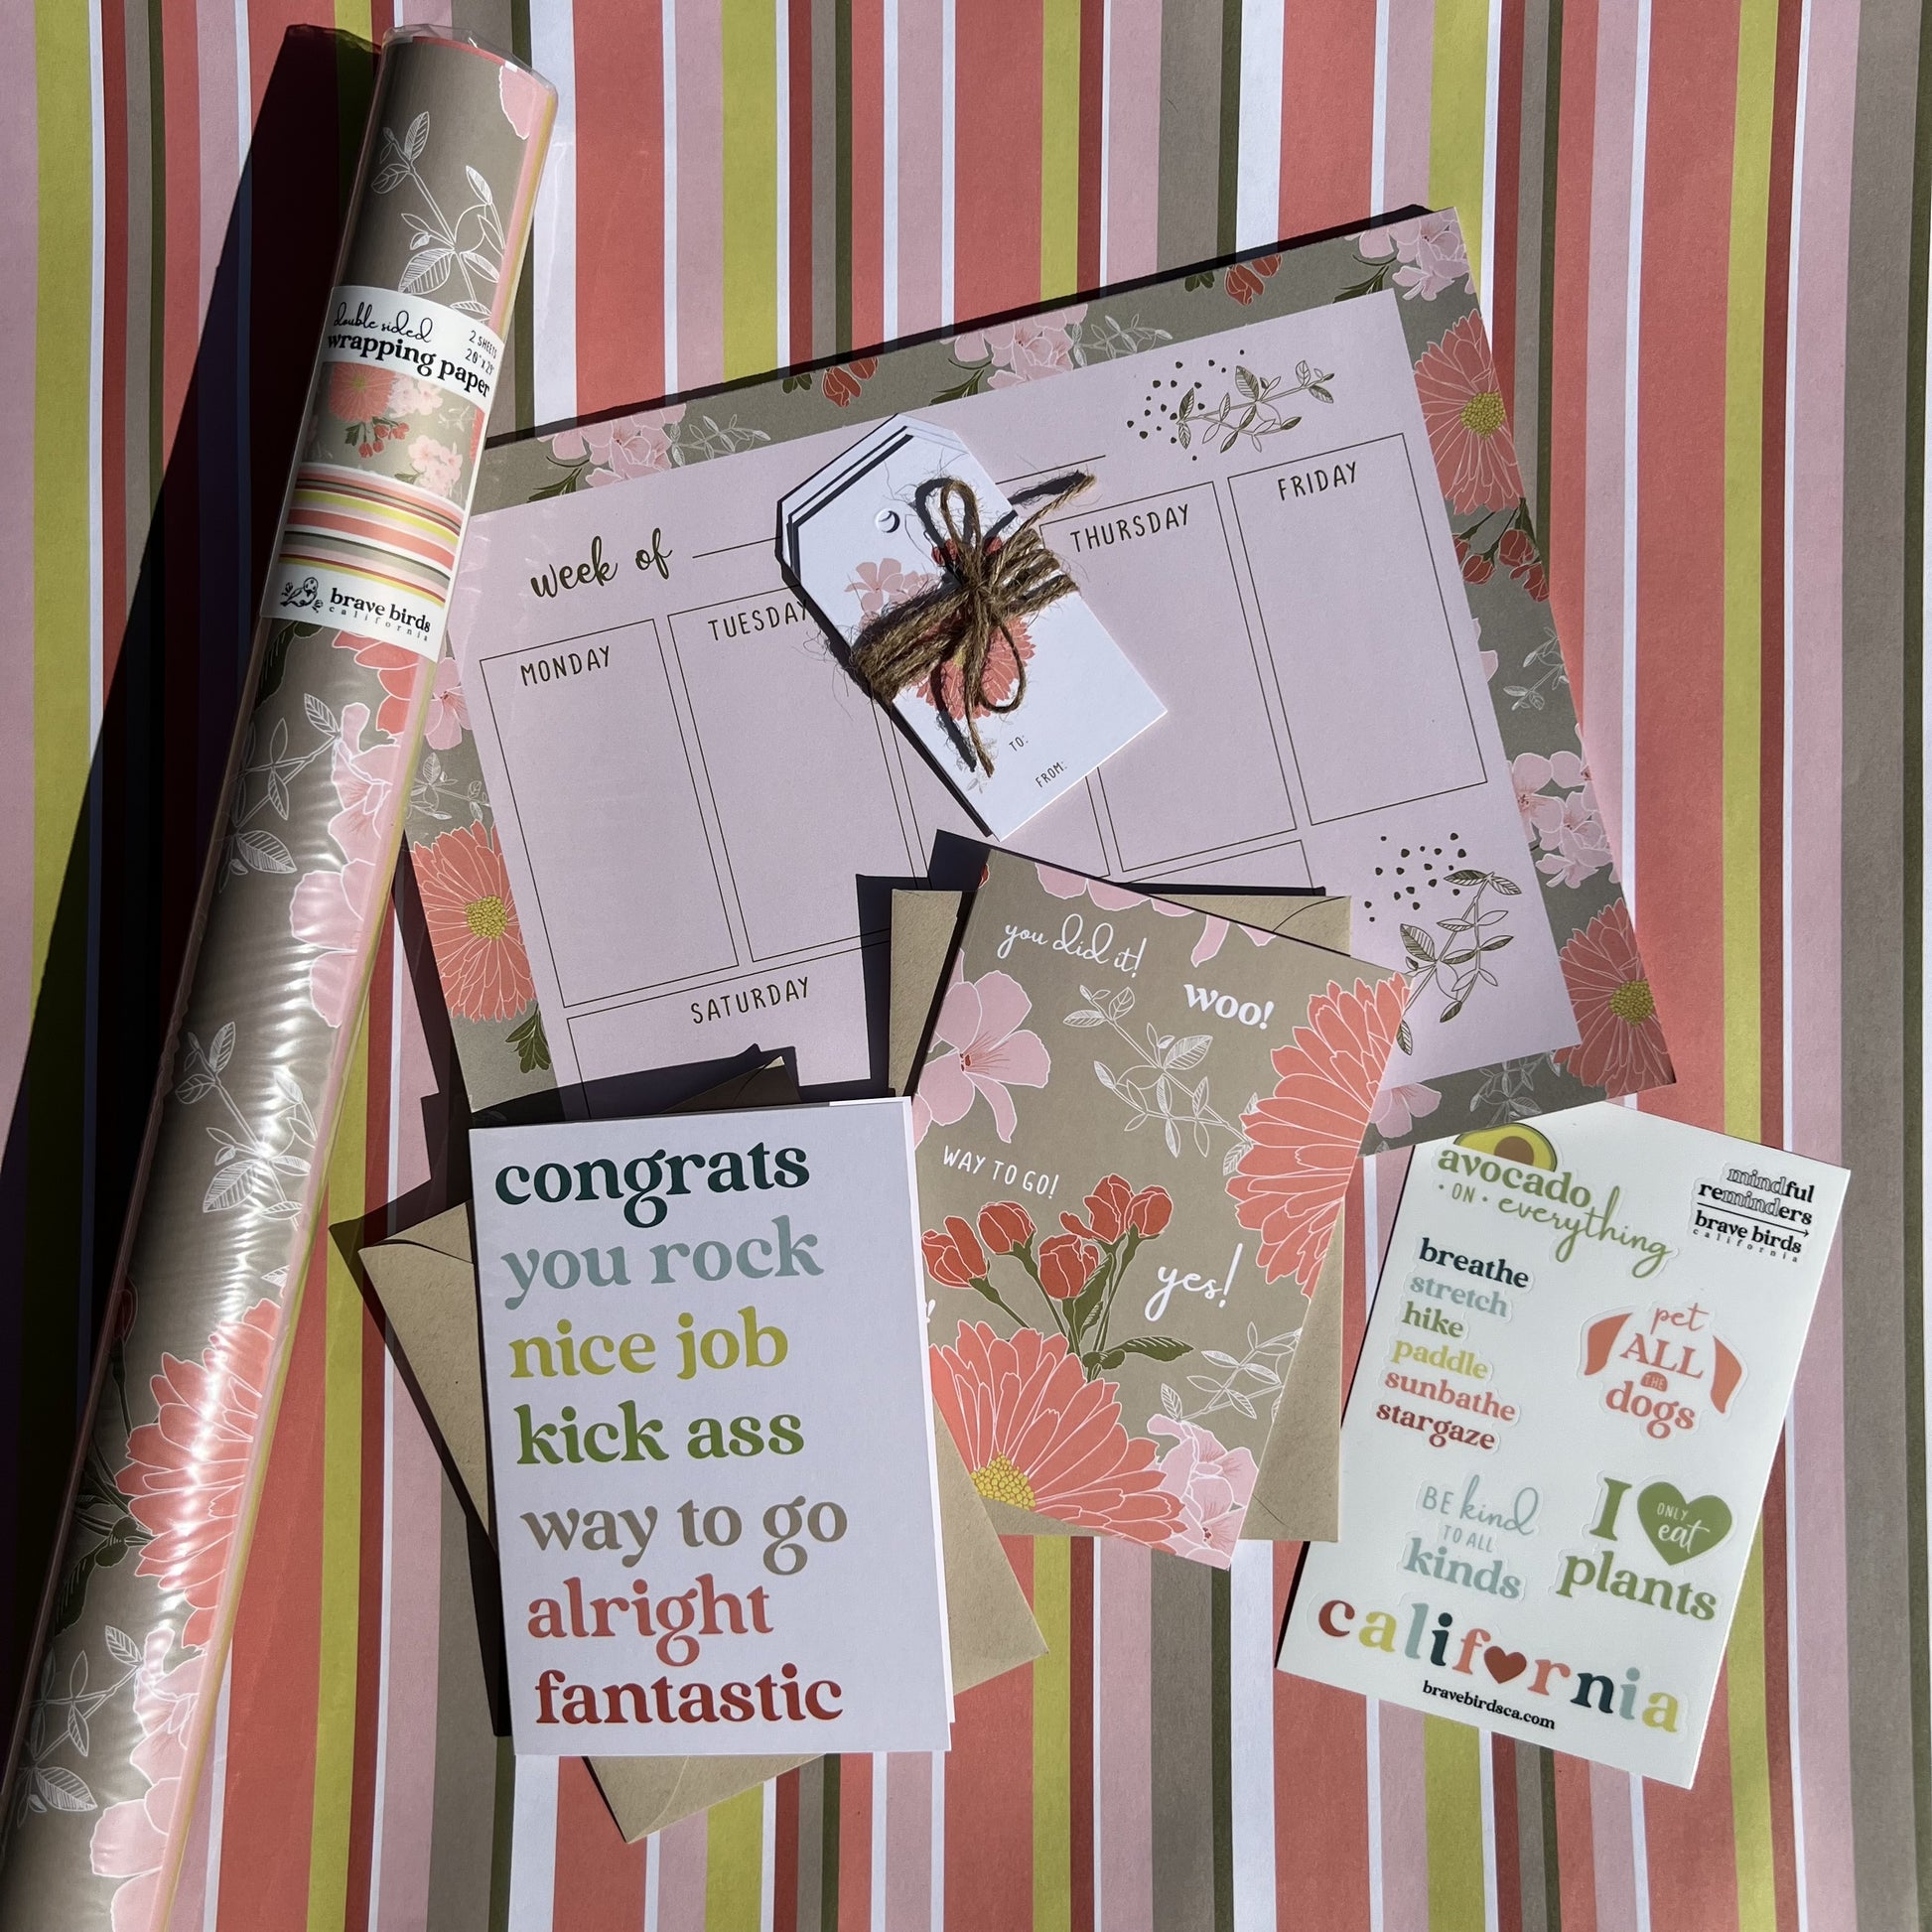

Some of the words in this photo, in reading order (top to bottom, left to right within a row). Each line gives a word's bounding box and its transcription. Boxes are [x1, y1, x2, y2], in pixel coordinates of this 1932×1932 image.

[333, 302, 378, 330] double
[381, 310, 433, 344] sided
[469, 330, 477, 344] 2
[478, 336, 497, 359] SHEETS
[328, 333, 437, 377] wrapping
[437, 358, 490, 398] paper
[1278, 462, 1358, 501] FRIDAY
[1070, 503, 1190, 553] THURSDAY
[530, 535, 619, 599] week
[634, 527, 673, 580] of
[329, 606, 428, 641] california
[330, 587, 385, 616] brave
[389, 604, 431, 633] birds
[707, 599, 807, 641] TUESDAY
[520, 645, 611, 687] MONDAY
[1009, 735, 1029, 752] TO:
[1035, 760, 1068, 788] FROM:
[997, 921, 1046, 959] you
[1052, 913, 1114, 965] did
[1114, 937, 1148, 978] it!
[690, 976, 809, 1025] SATURDAY
[1183, 983, 1275, 1030] woo!
[494, 1142, 811, 1228] congrats
[943, 1145, 986, 1175] WAY
[992, 1161, 1018, 1185] TO
[1023, 1170, 1059, 1199] GO!
[1438, 1147, 1591, 1209] avocado
[1726, 1169, 1815, 1203] mindful
[1698, 1183, 1813, 1226] reminders
[1450, 1182, 1476, 1204] ON
[1497, 1184, 1673, 1279] everything
[1693, 1228, 1798, 1263] california
[1695, 1209, 1748, 1239] brave
[1751, 1225, 1802, 1254] birds
[499, 1241, 631, 1311] you
[649, 1215, 825, 1285] rock
[1144, 1243, 1243, 1321] yes!
[1418, 1237, 1530, 1289] breathe
[1410, 1272, 1508, 1317] stretch
[1650, 1303, 1710, 1335] pet
[508, 1318, 656, 1379] nice
[676, 1305, 790, 1381] job
[1401, 1301, 1465, 1338] hike
[1391, 1336, 1490, 1380] paddle
[1619, 1332, 1704, 1379] ALL
[1384, 1371, 1517, 1422] sunbathe
[1644, 1374, 1665, 1390] THE
[513, 1400, 670, 1464] kick
[687, 1413, 805, 1459] ass
[1375, 1401, 1496, 1450] stargaze
[1605, 1380, 1695, 1440] dogs
[1422, 1485, 1453, 1516] BE
[1459, 1474, 1539, 1537] kind
[1588, 1476, 1633, 1541] I
[1657, 1501, 1689, 1519] ONLY
[519, 1505, 659, 1568] way
[677, 1498, 743, 1548] to
[761, 1495, 849, 1576] go
[1443, 1524, 1462, 1544] TO
[1465, 1531, 1493, 1553] ALL
[1658, 1522, 1711, 1555] eat
[1403, 1537, 1522, 1600] kinds
[1556, 1550, 1718, 1622] plants
[527, 1574, 774, 1668] alright
[1317, 1598, 1681, 1733] califrnia
[534, 1663, 844, 1725] fantastic
[1422, 1679, 1556, 1730] bravebirdsca.com
